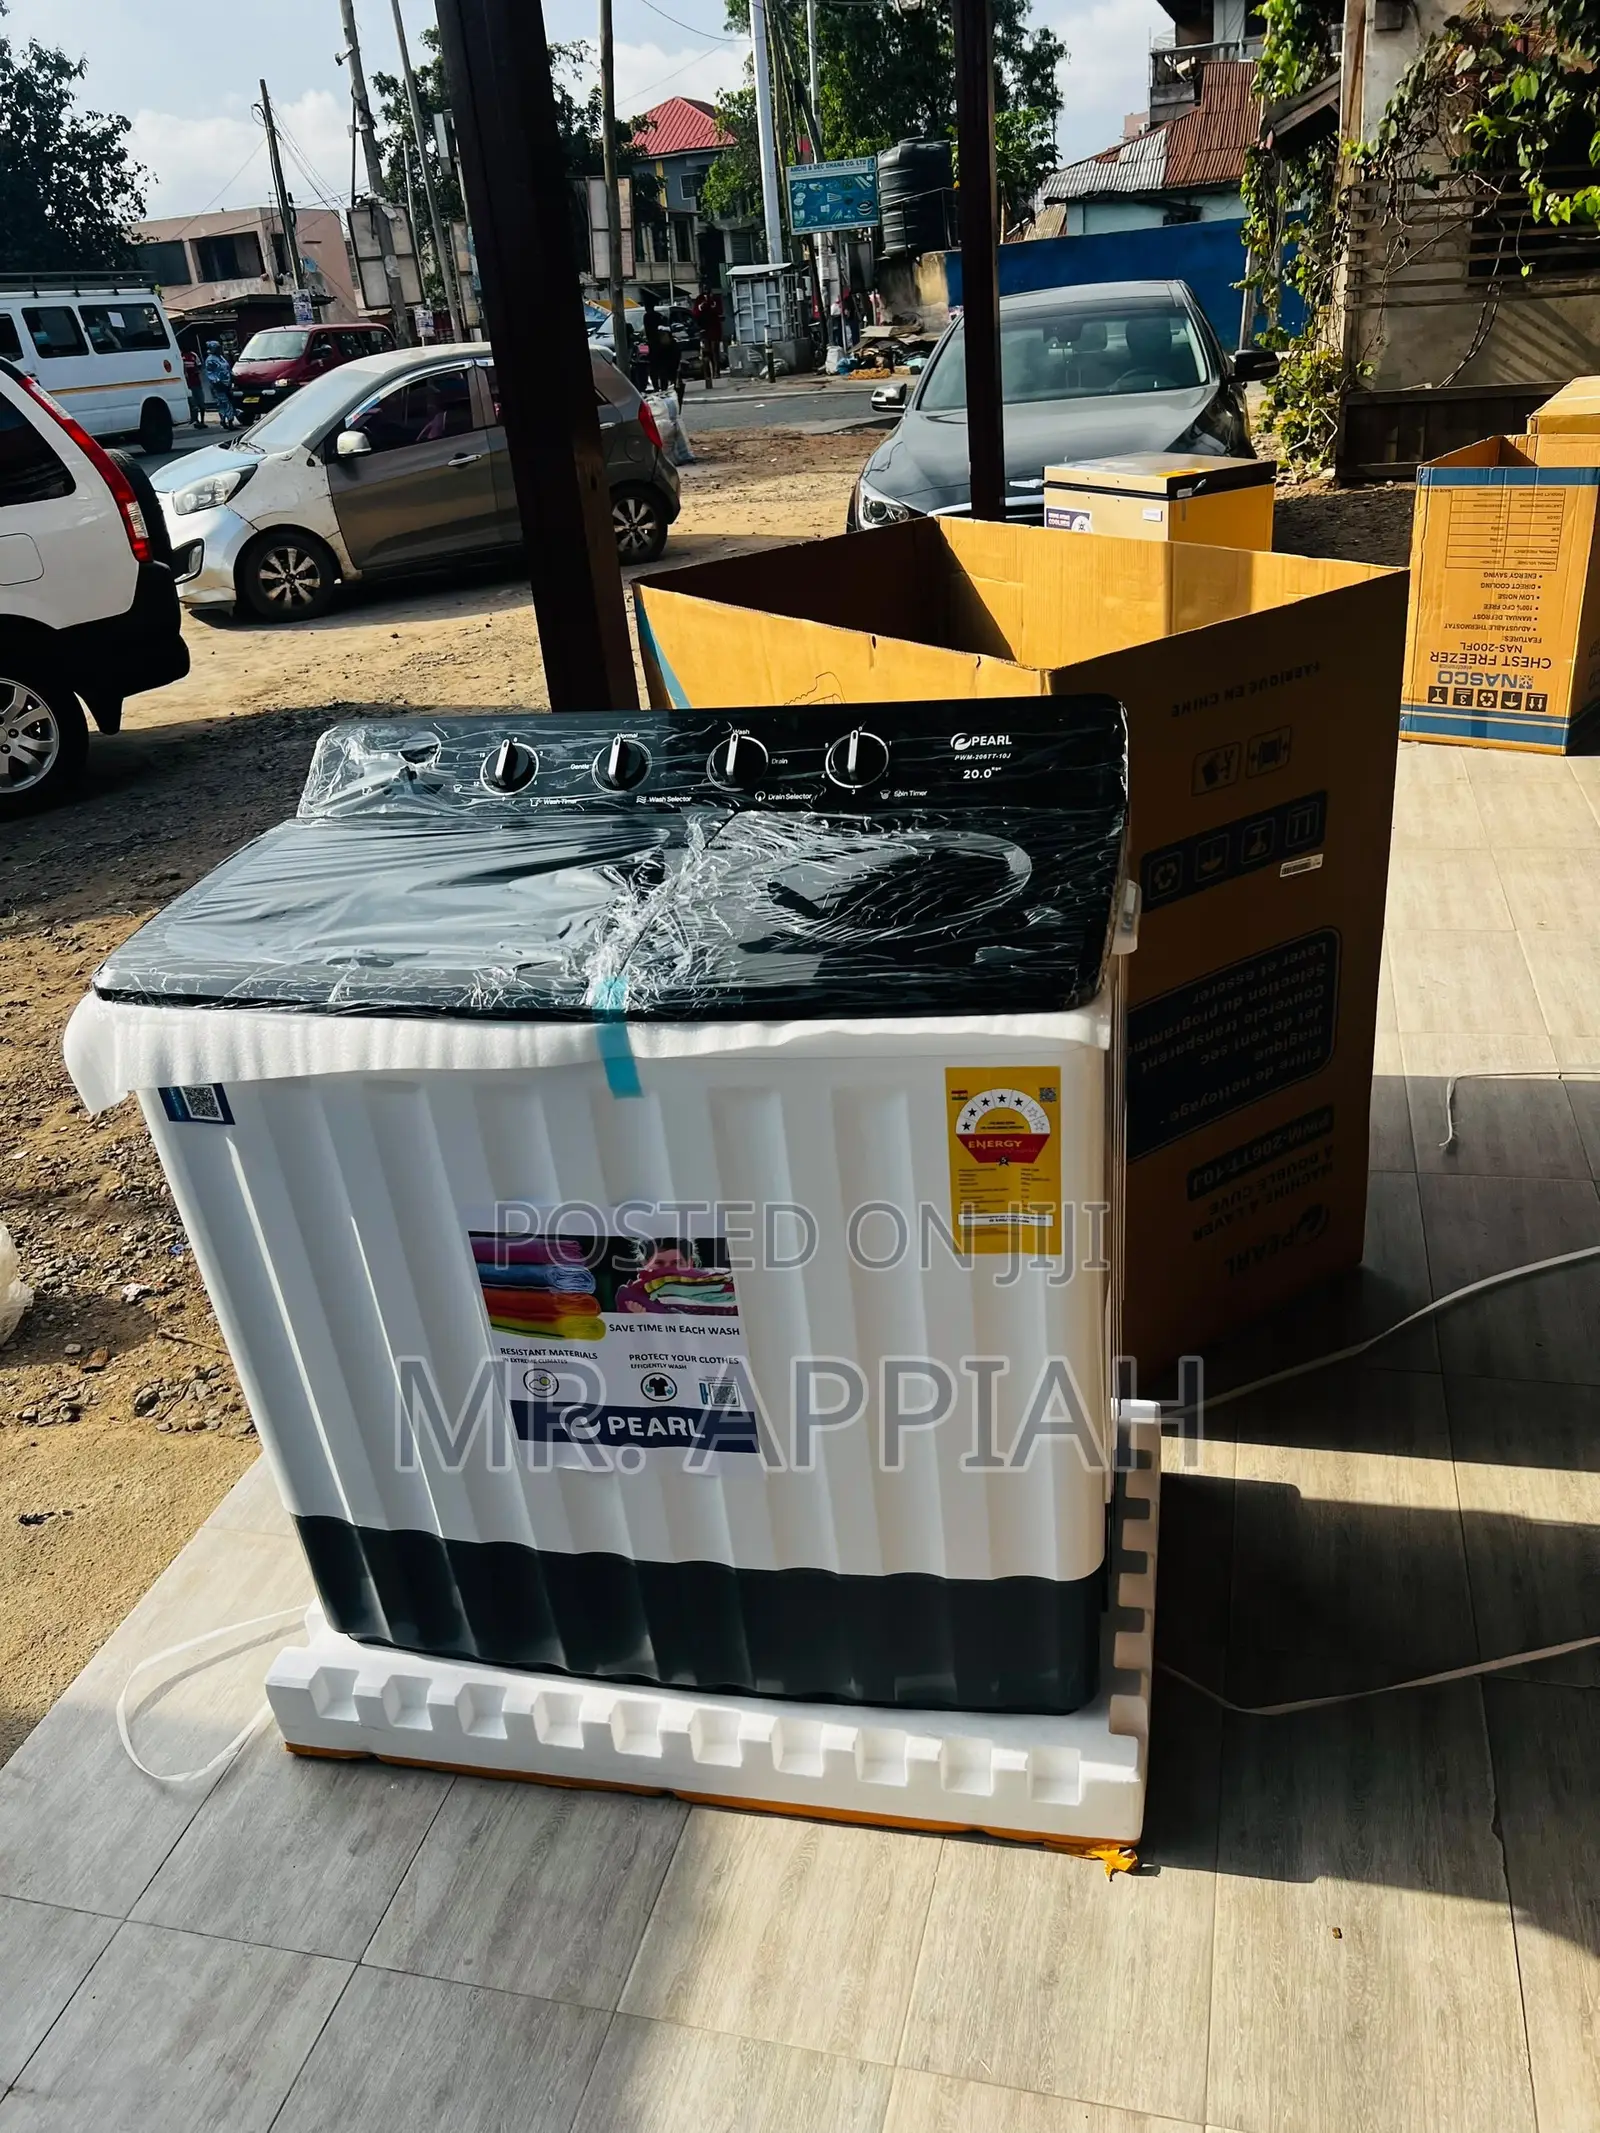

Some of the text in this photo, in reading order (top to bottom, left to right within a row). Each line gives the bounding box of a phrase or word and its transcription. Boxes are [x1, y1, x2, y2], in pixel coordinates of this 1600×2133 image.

[1509, 572, 1537, 580] ENERGY
[1472, 613, 1532, 622] MANUAL DEFROST
[1444, 623, 1531, 632] ADJUSTABLE THERMOSTAT
[1460, 642, 1523, 654] NAS-200FL
[1502, 635, 1542, 644] FEATURES:
[1429, 651, 1551, 670] CHEST FREEZER
[1437, 670, 1518, 689] NASCO
[1224, 685, 1245, 701] EN
[1460, 695, 1467, 705] 3
[1171, 692, 1219, 718] CHINE
[971, 735, 1012, 746] PEARL
[963, 768, 992, 779] 20.0
[894, 790, 908, 798] Spin
[1260, 961, 1278, 978] et
[1192, 970, 1255, 1006] essorer
[1223, 995, 1242, 1013] du
[1273, 1016, 1292, 1033] de
[1140, 1019, 1237, 1074] transparent
[1234, 1028, 1268, 1052] vent
[1254, 1025, 1322, 1061] magique
[1200, 1044, 1229, 1065] sec
[1255, 1065, 1274, 1082] de
[968, 1139, 1023, 1150] ENERGY
[1257, 1151, 1318, 1190] DOUBLE
[1209, 1185, 1252, 1216] CUVE
[1192, 1206, 1244, 1242] LAVER
[608, 1323, 740, 1335] SAVE TIME IN EACH WASH
[500, 1347, 598, 1360] RESISTANT MATERIALS
[629, 1353, 740, 1365] PROTECT YOUR CLOTHES
[607, 1415, 705, 1439] PEARL
